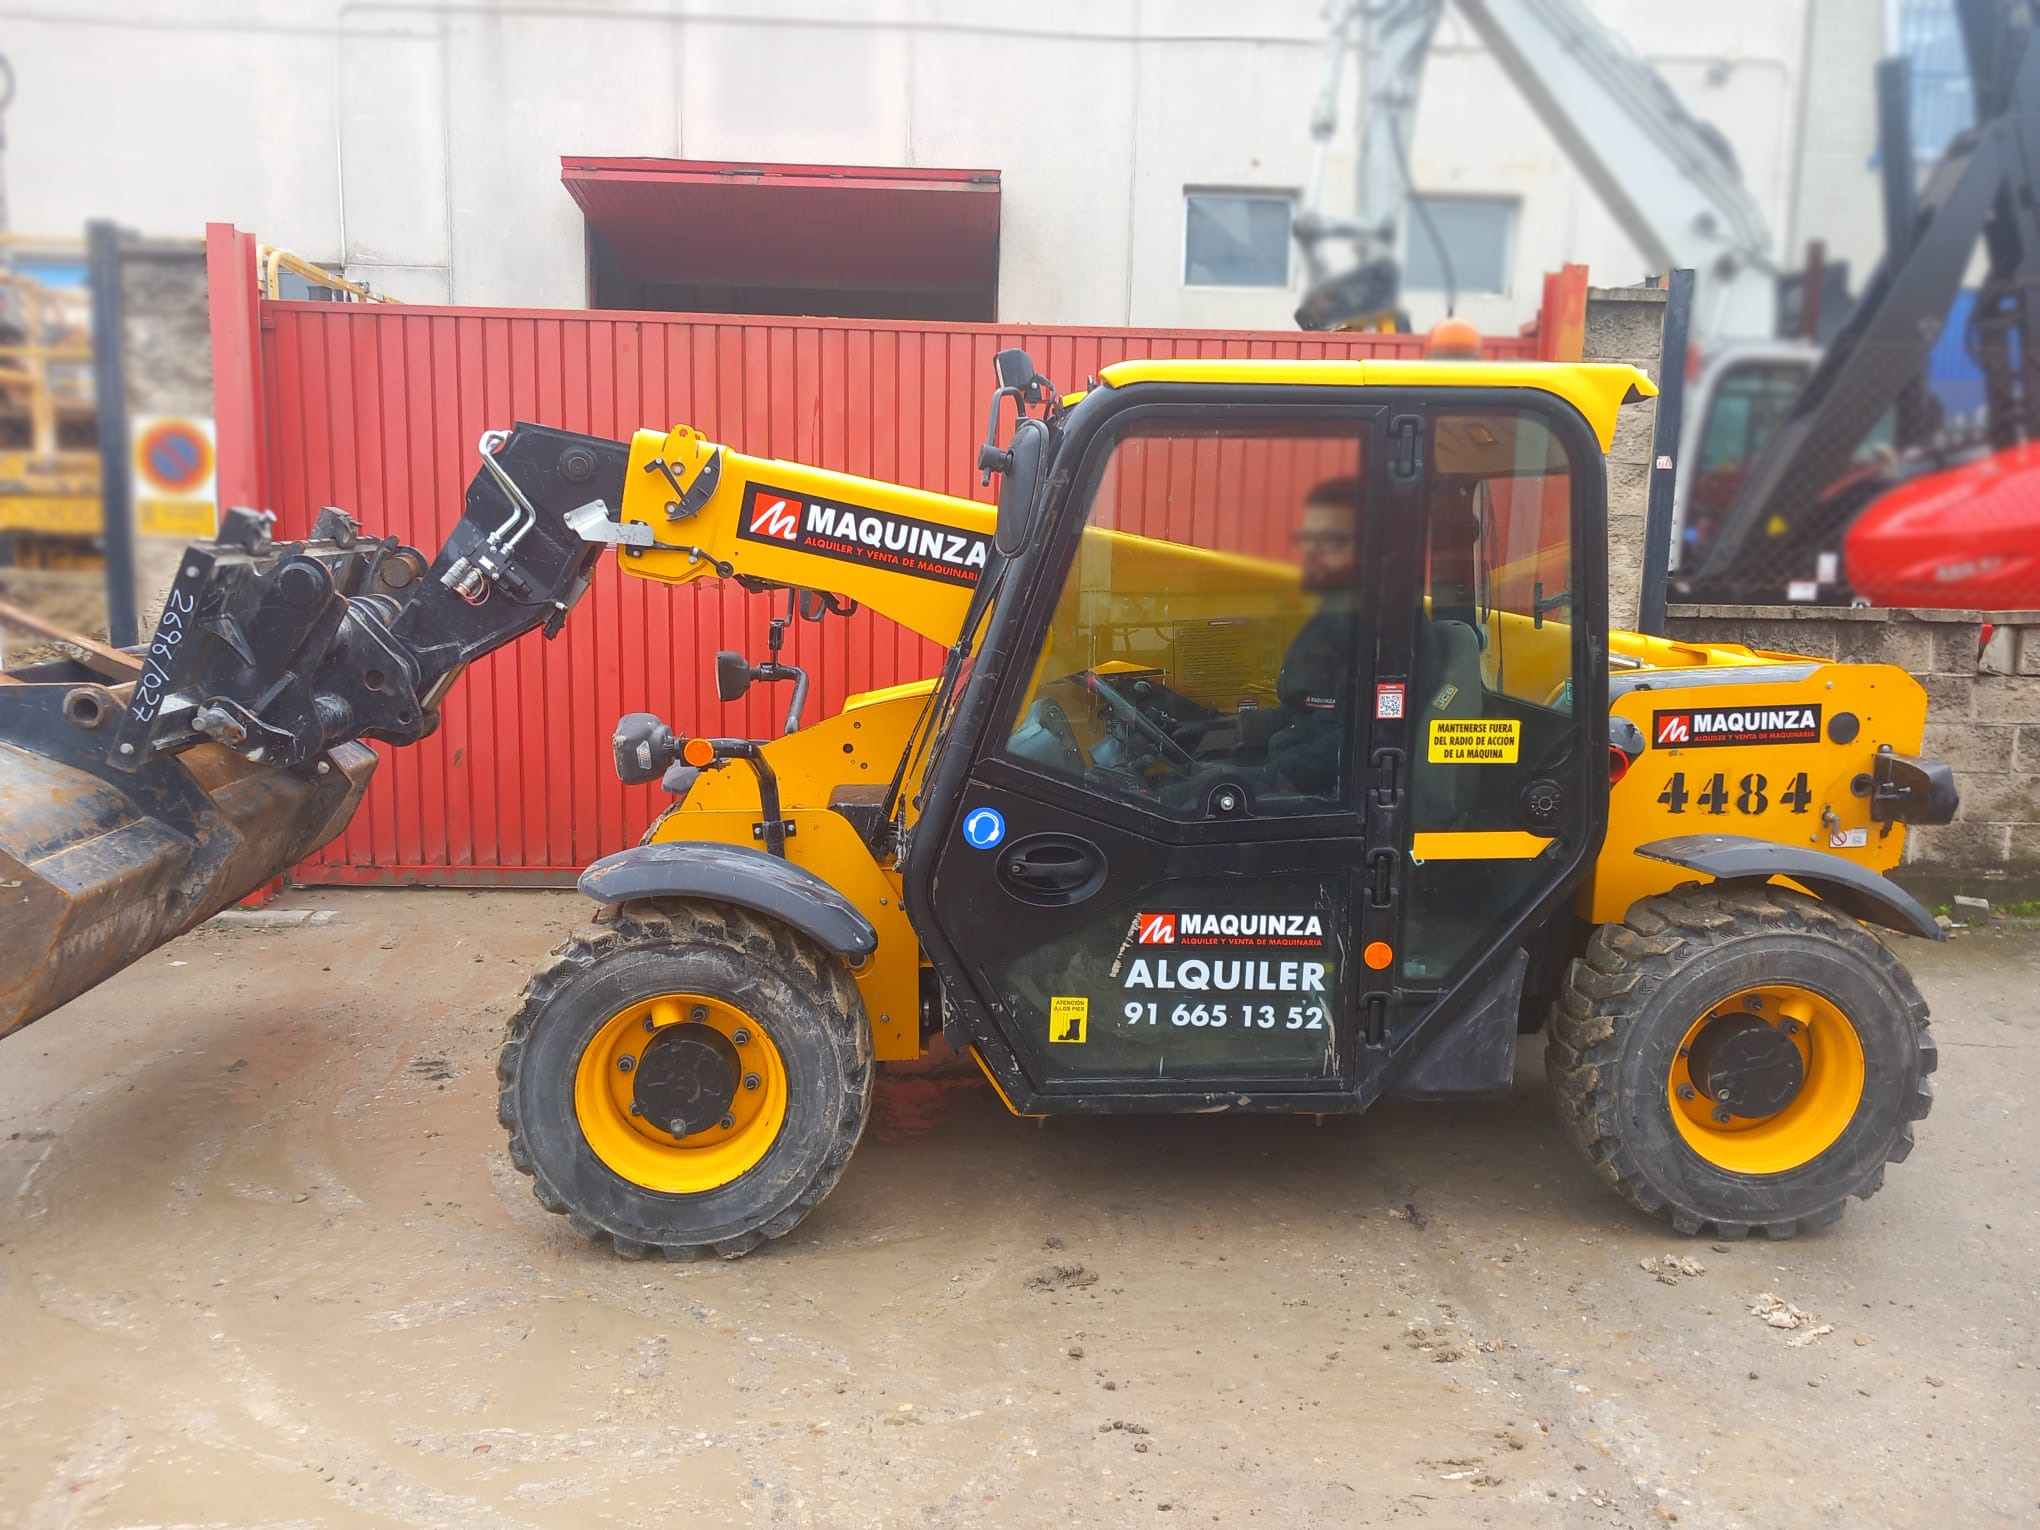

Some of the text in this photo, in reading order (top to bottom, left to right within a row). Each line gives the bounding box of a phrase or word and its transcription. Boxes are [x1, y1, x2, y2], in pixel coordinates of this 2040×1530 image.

[807, 504, 987, 568] MAQUINZA
[804, 536, 979, 582] ALQUILER Y VENTA DE MAQUINARI
[1440, 687, 1455, 707] JCB
[1437, 723, 1512, 733] MANTENERSE FUERA
[1693, 710, 1816, 732] MAQUINZA
[1434, 736, 1447, 746] DEL
[1449, 736, 1474, 746] RADIO
[1475, 736, 1485, 746] DE
[1443, 749, 1453, 759] DE
[1455, 749, 1464, 759] LA
[1657, 772, 1812, 815] 4484
[1180, 914, 1323, 936] MAQUINZA
[1229, 938, 1254, 946] VENTA
[1124, 959, 1326, 992] ALQUILER
[1124, 1002, 1323, 1030] 91 665 13 52
